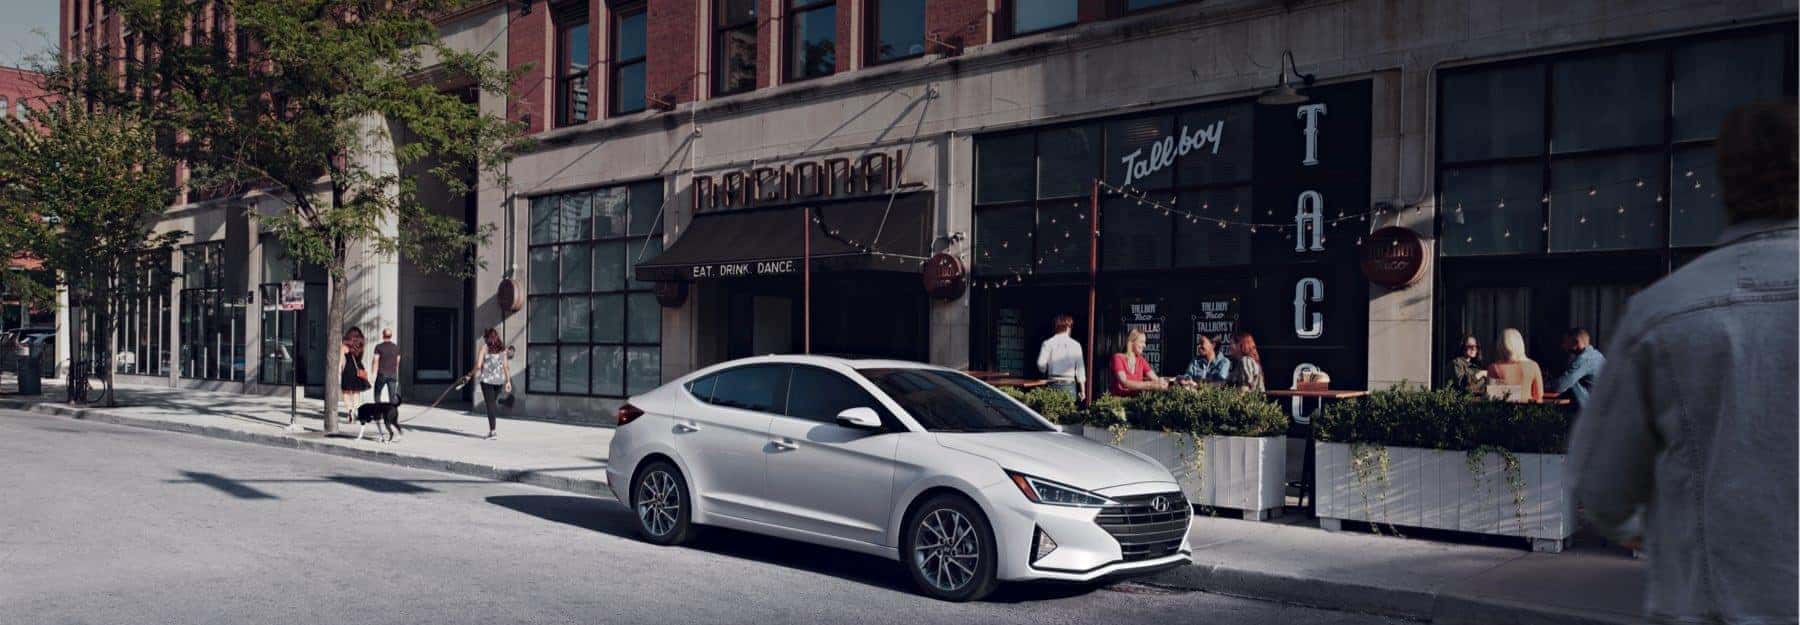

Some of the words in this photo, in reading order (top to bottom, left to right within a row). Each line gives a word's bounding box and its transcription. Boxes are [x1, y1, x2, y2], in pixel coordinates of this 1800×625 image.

[1122, 119, 1224, 185] Tallboy
[693, 265, 715, 278] EAT.
[757, 260, 795, 274] DANCE.
